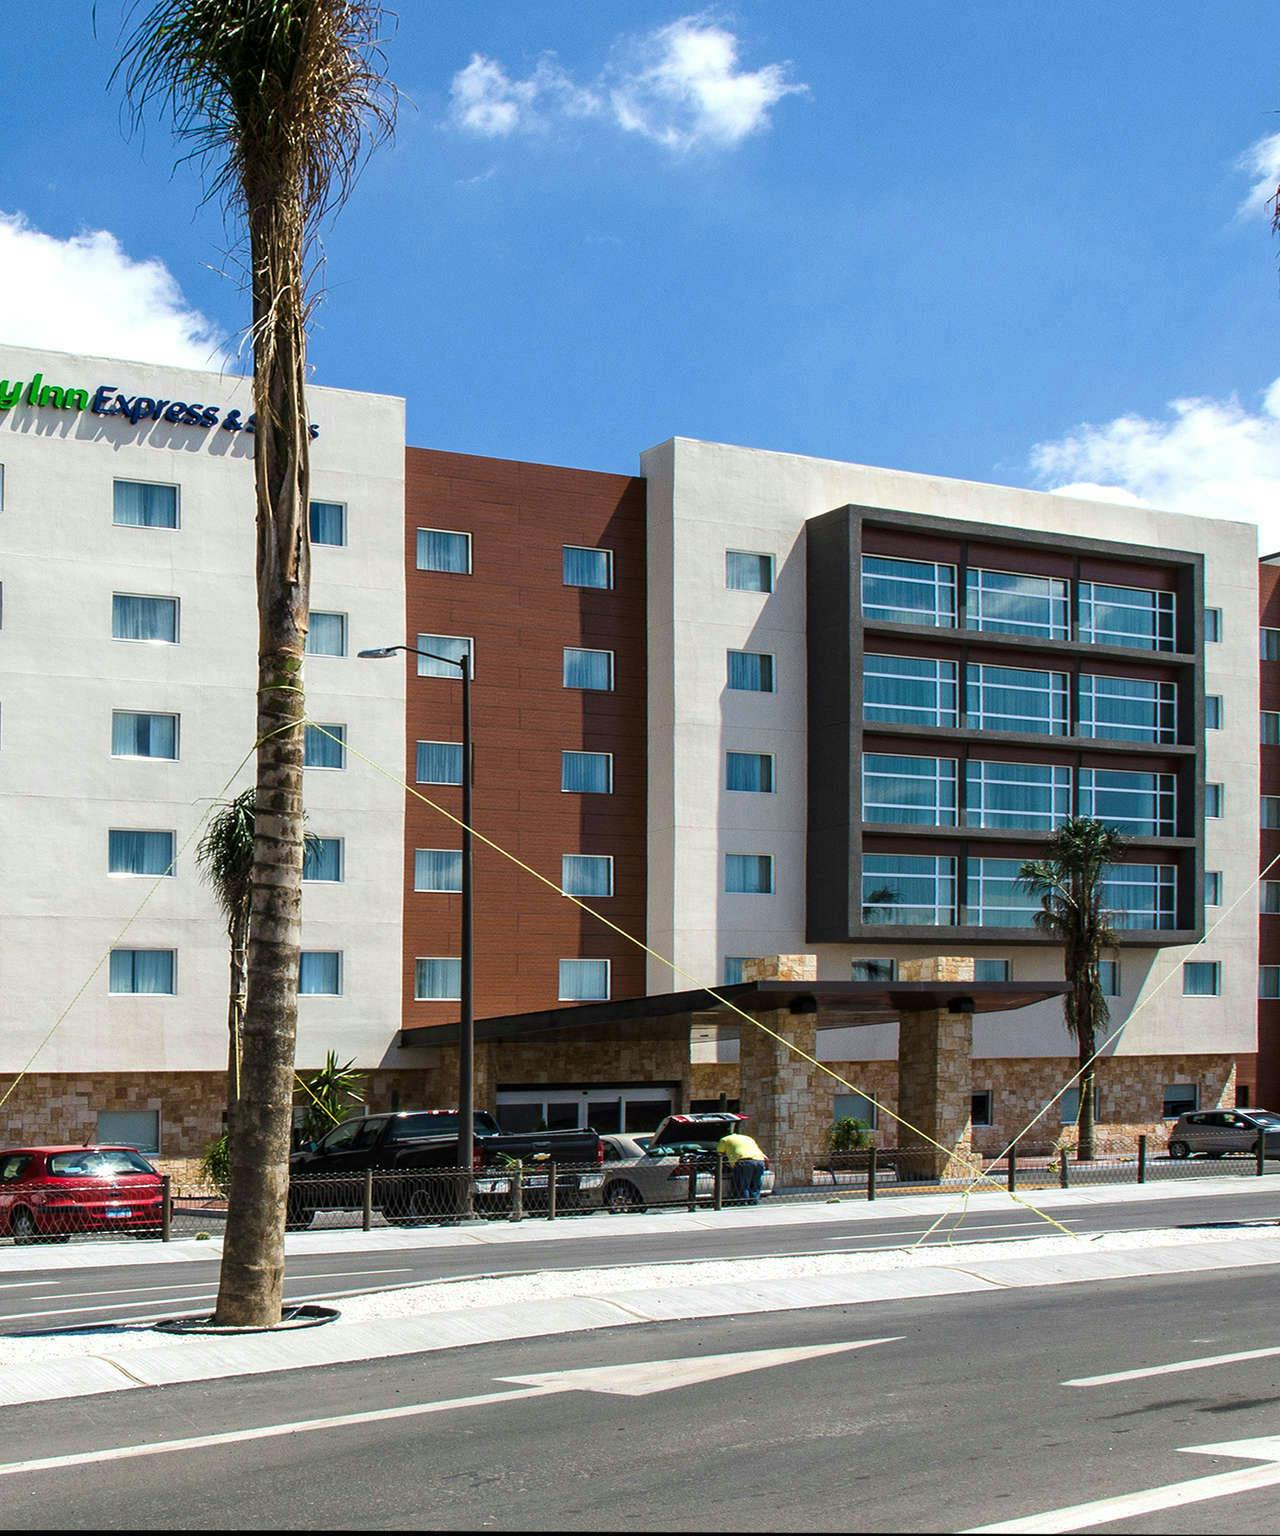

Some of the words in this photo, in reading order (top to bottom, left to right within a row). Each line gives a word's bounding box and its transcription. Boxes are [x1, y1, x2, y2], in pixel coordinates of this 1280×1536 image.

[27, 373, 89, 411] Inn
[91, 385, 220, 427] Express
[222, 409, 244, 432] &
